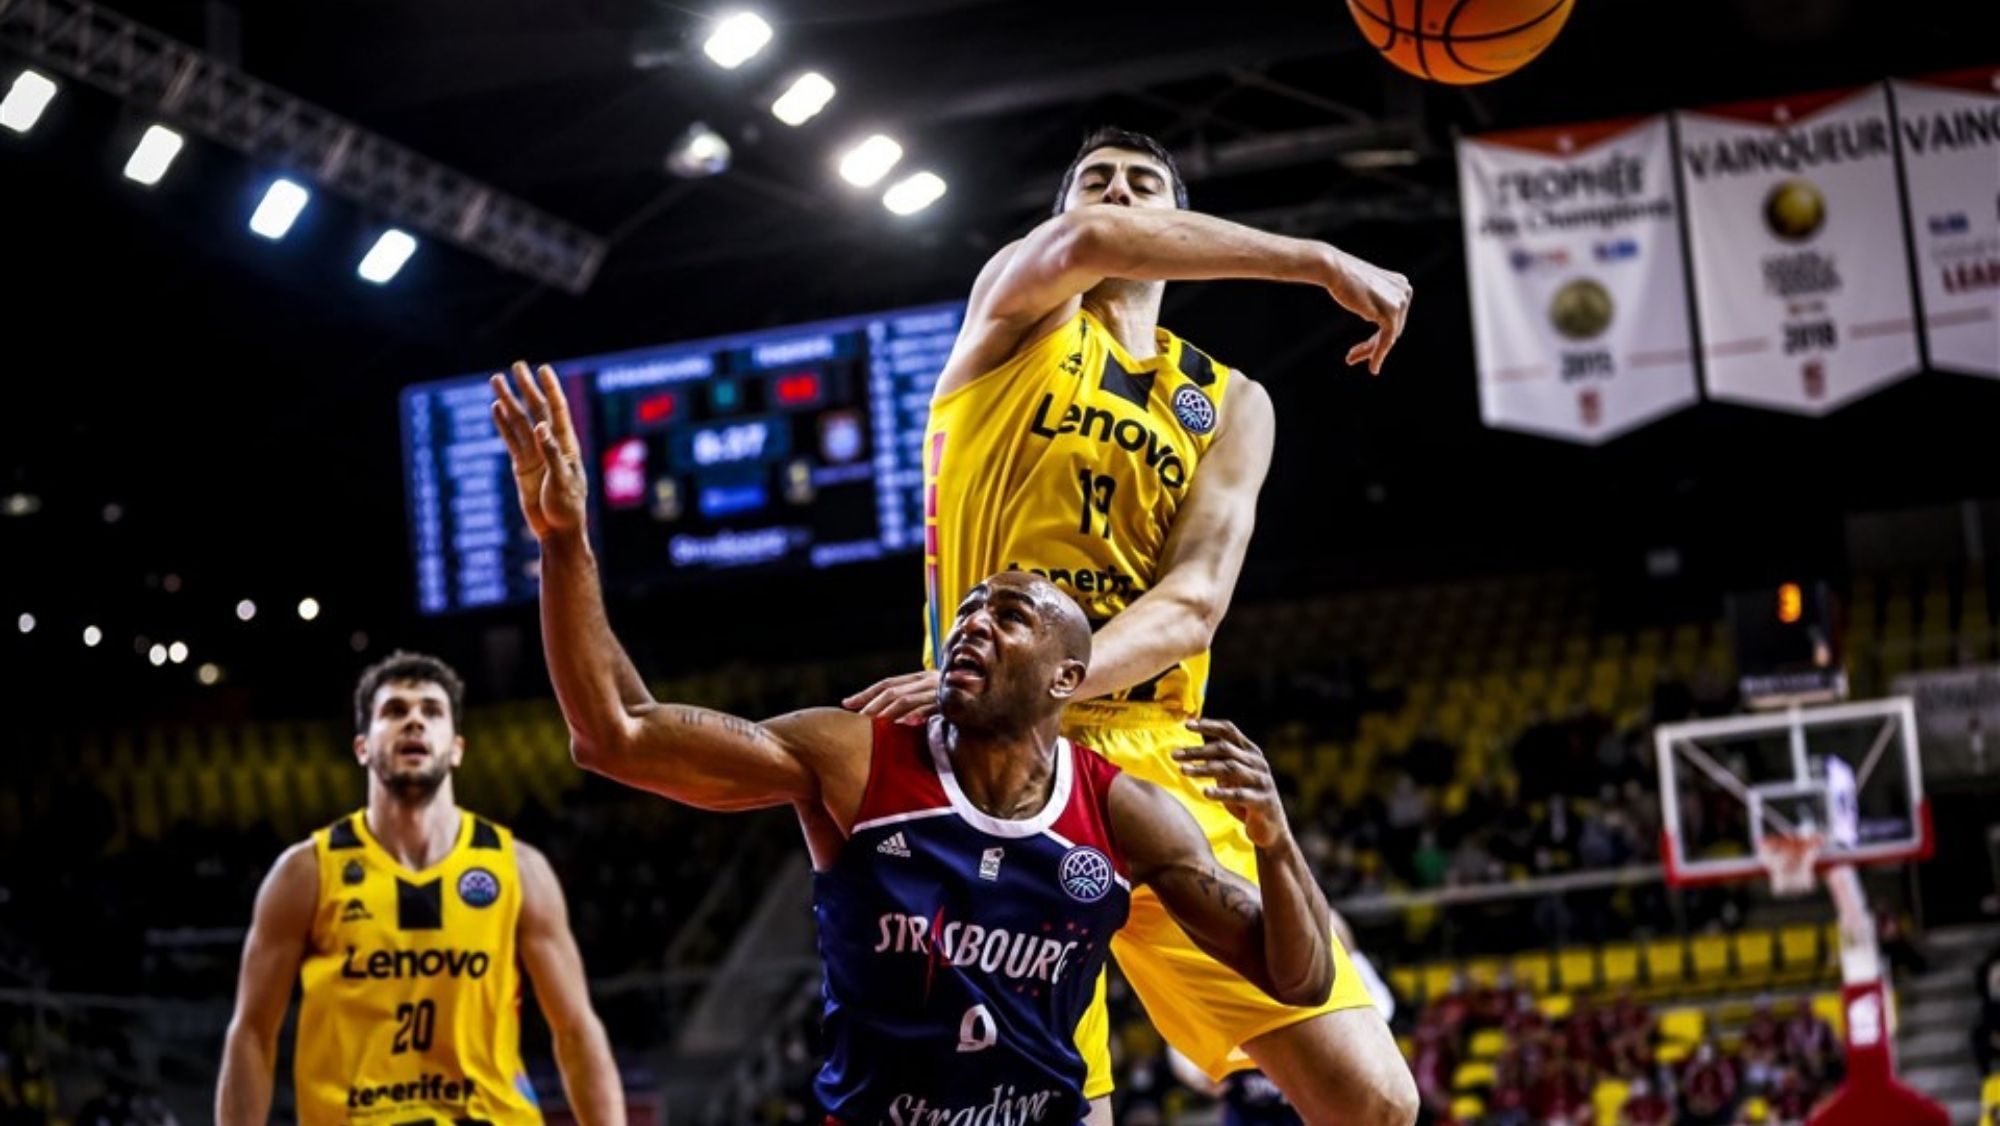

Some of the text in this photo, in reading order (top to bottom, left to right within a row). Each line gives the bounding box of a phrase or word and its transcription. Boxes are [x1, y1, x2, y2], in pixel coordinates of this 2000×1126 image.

[1685, 116, 1888, 181] VAINQUEUR
[1031, 393, 1185, 490] Lenovo
[1079, 467, 1116, 541] 19
[342, 943, 489, 980] Lenovo
[392, 998, 435, 1054] 20
